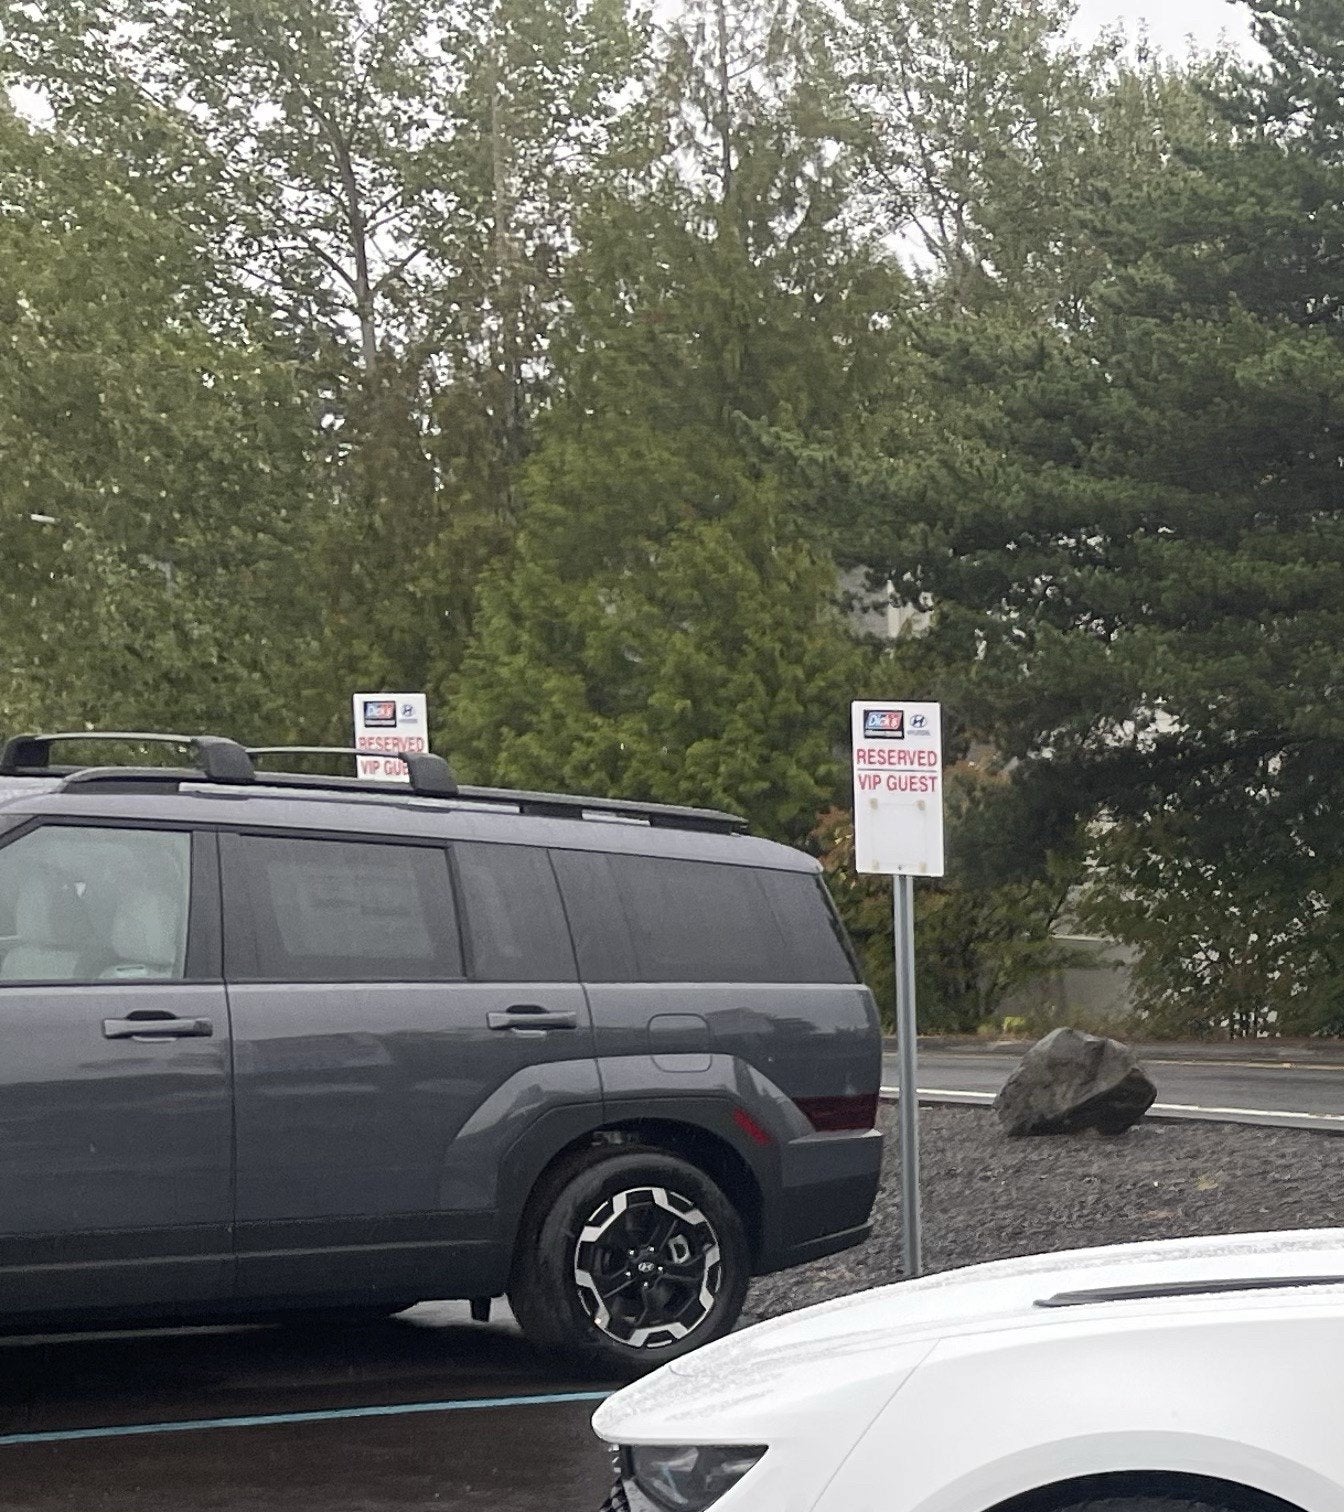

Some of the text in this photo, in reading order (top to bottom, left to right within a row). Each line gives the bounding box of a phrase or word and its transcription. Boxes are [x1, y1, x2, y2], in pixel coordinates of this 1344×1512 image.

[358, 736, 425, 752] RESERVED
[857, 749, 937, 767] RESERVED
[361, 759, 380, 775] VIP
[858, 775, 938, 792] VIP GUEST
